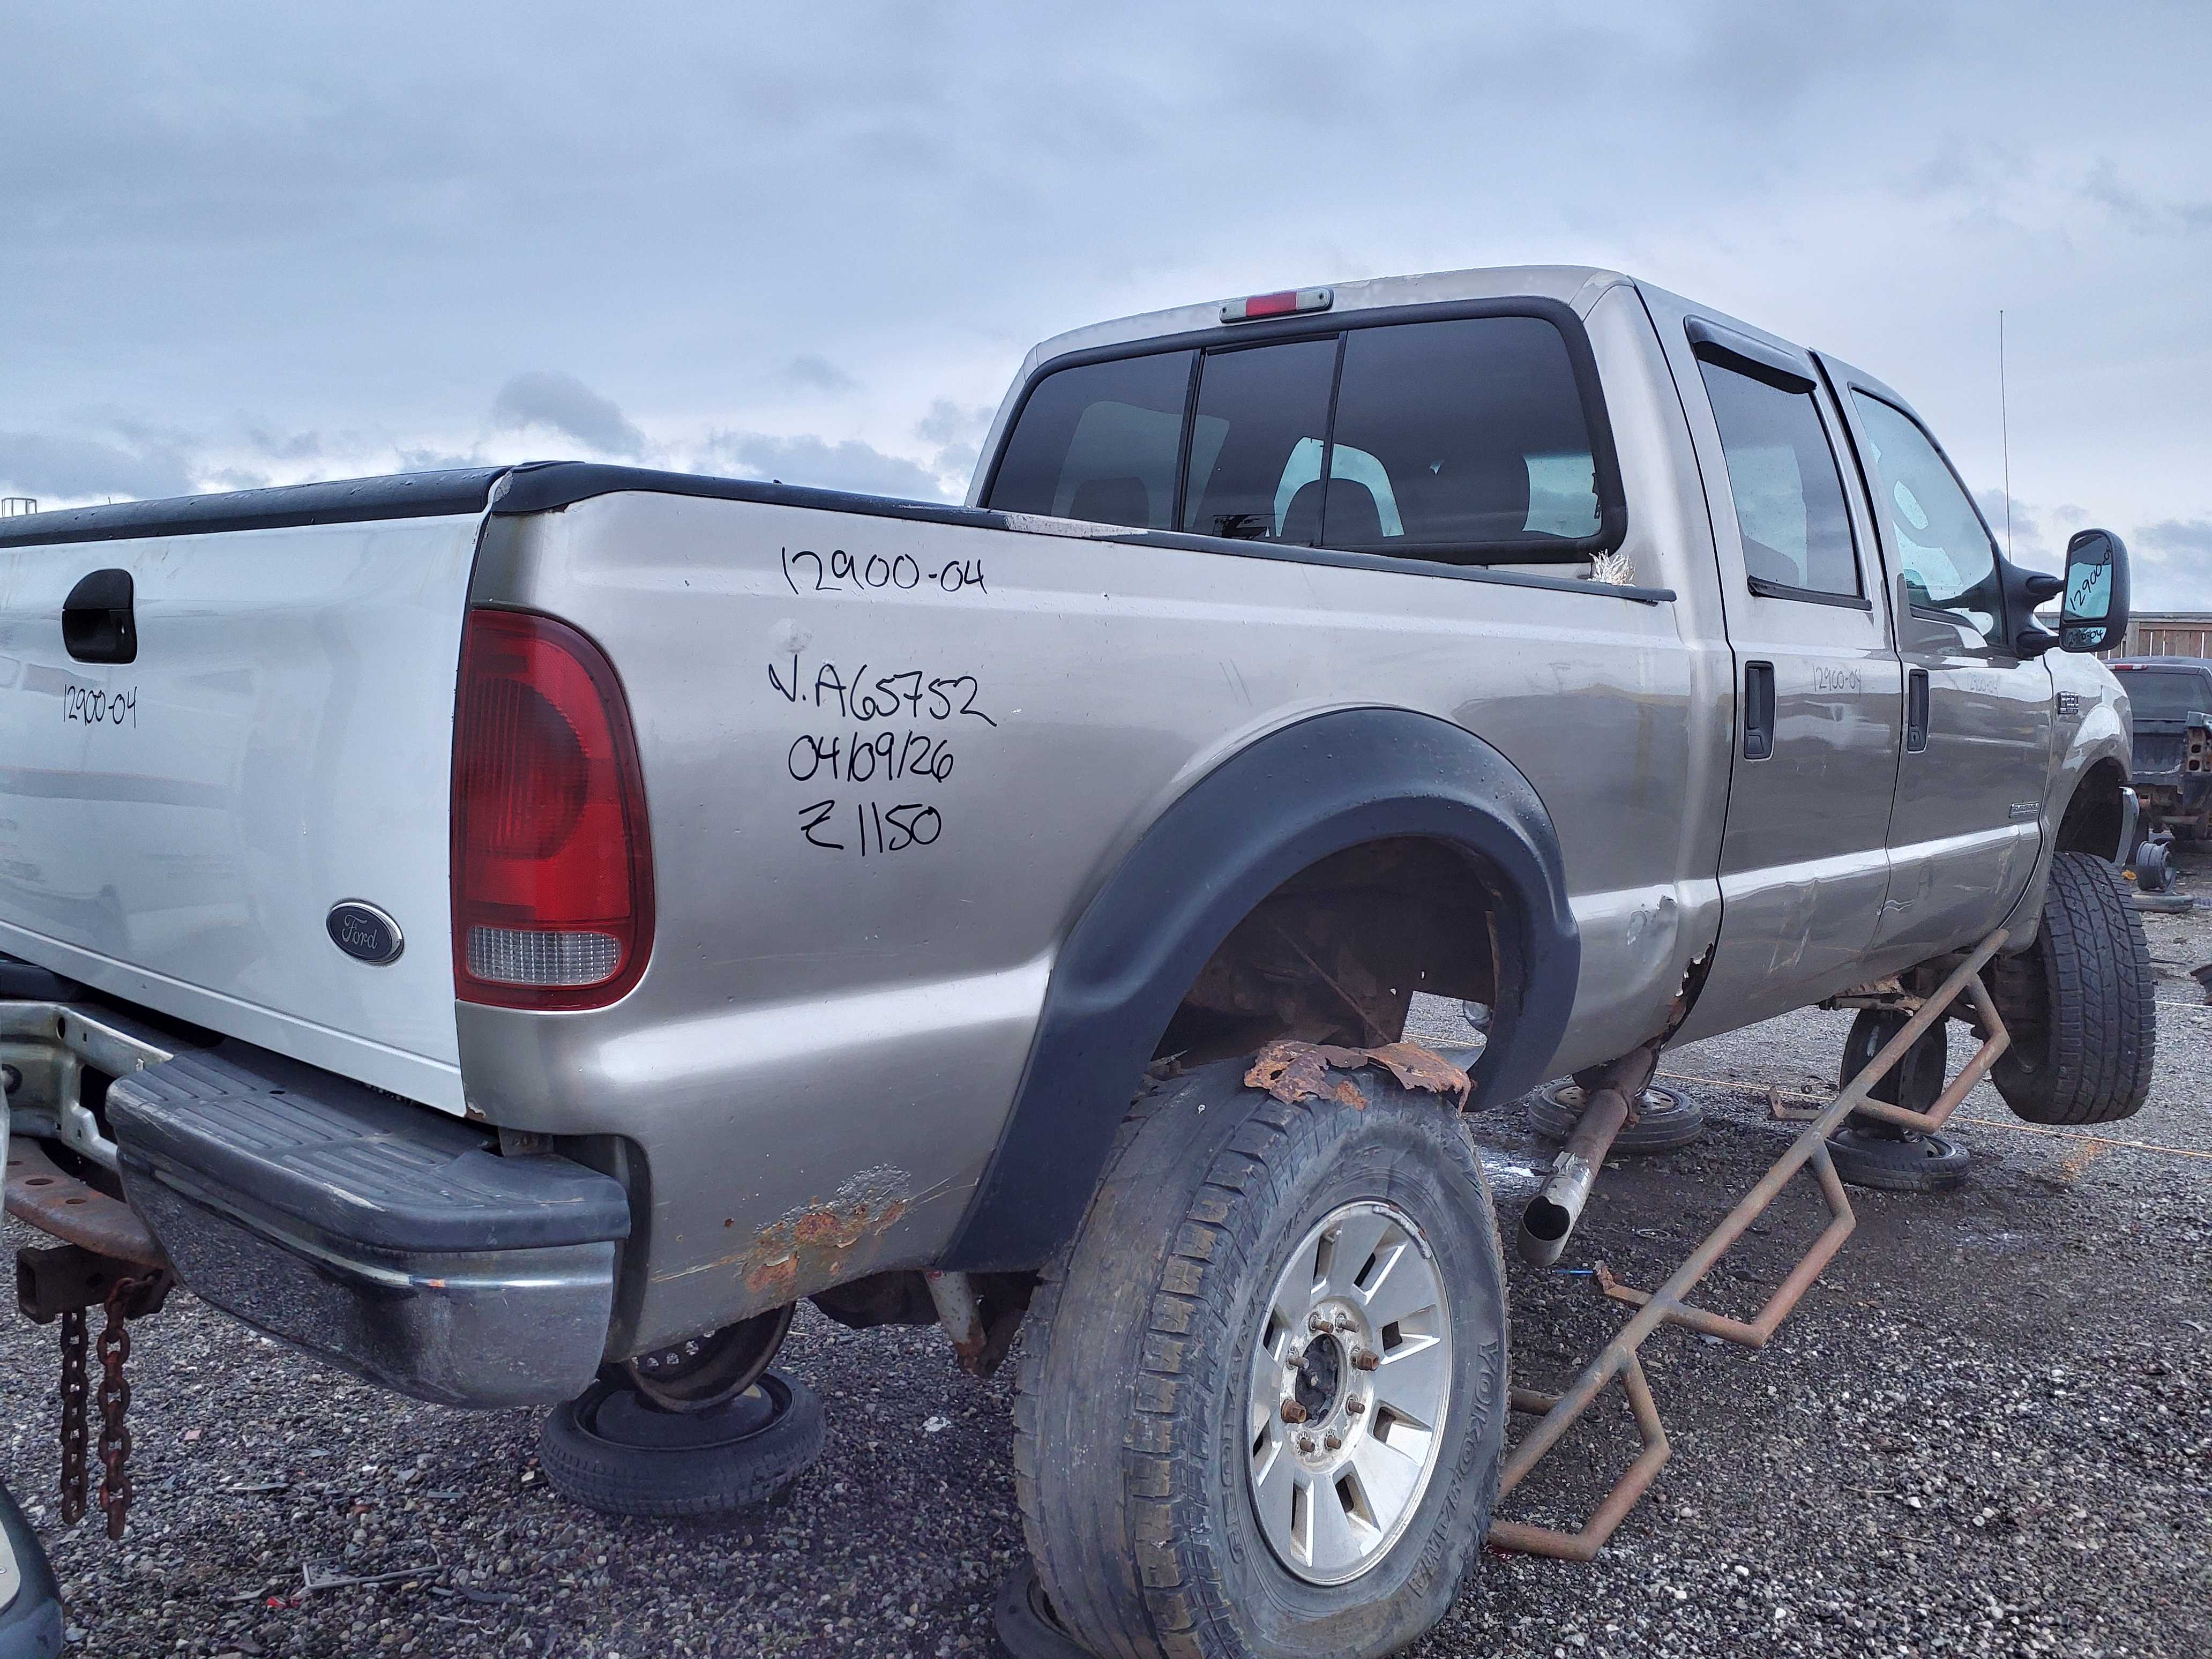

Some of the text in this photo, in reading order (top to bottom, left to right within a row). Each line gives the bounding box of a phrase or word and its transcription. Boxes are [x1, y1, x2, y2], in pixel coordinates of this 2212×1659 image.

[782, 547, 988, 595] 12900-04
[63, 684, 138, 729] 12900-04
[788, 731, 954, 783] 04/09/26
[341, 914, 378, 950] Ford
[1407, 1341, 1499, 1598] YOKOHAMA
